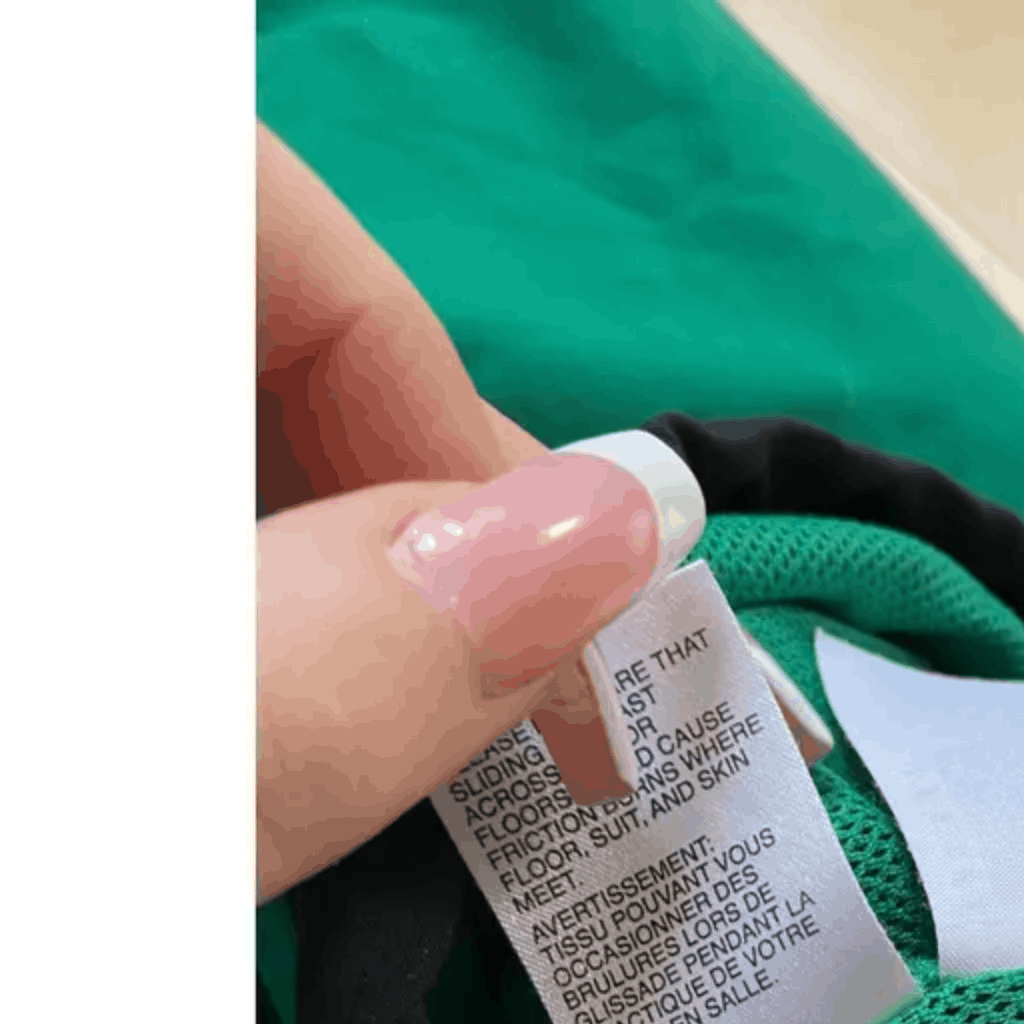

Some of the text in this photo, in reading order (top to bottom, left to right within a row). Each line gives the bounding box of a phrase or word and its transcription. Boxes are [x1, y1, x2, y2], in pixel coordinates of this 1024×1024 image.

[650, 627, 710, 671] THAT
[449, 745, 545, 802] SLIDING
[465, 765, 562, 827] ACROSS
[474, 701, 734, 848] FLOORS CAUSE
[486, 806, 598, 871] FRICTION
[679, 713, 764, 770] WHERE
[499, 840, 591, 892] FLOOR,
[589, 807, 649, 848] SUIT,
[650, 780, 695, 819] AND
[697, 748, 750, 790] SKIN
[512, 869, 584, 914] MEET.
[532, 835, 714, 945] AVERTISSEMENT:
[539, 828, 776, 965] TISSU POUVANT VOUS
[553, 864, 759, 987] OCCASIONNER DES
[682, 905, 779, 974] PENDANT
[785, 890, 816, 917] LA
[562, 882, 776, 1010] BRULURES LORS DE
[705, 968, 779, 1018] SALLE.
[709, 957, 742, 988] DE
[742, 915, 820, 967] VOTRE
